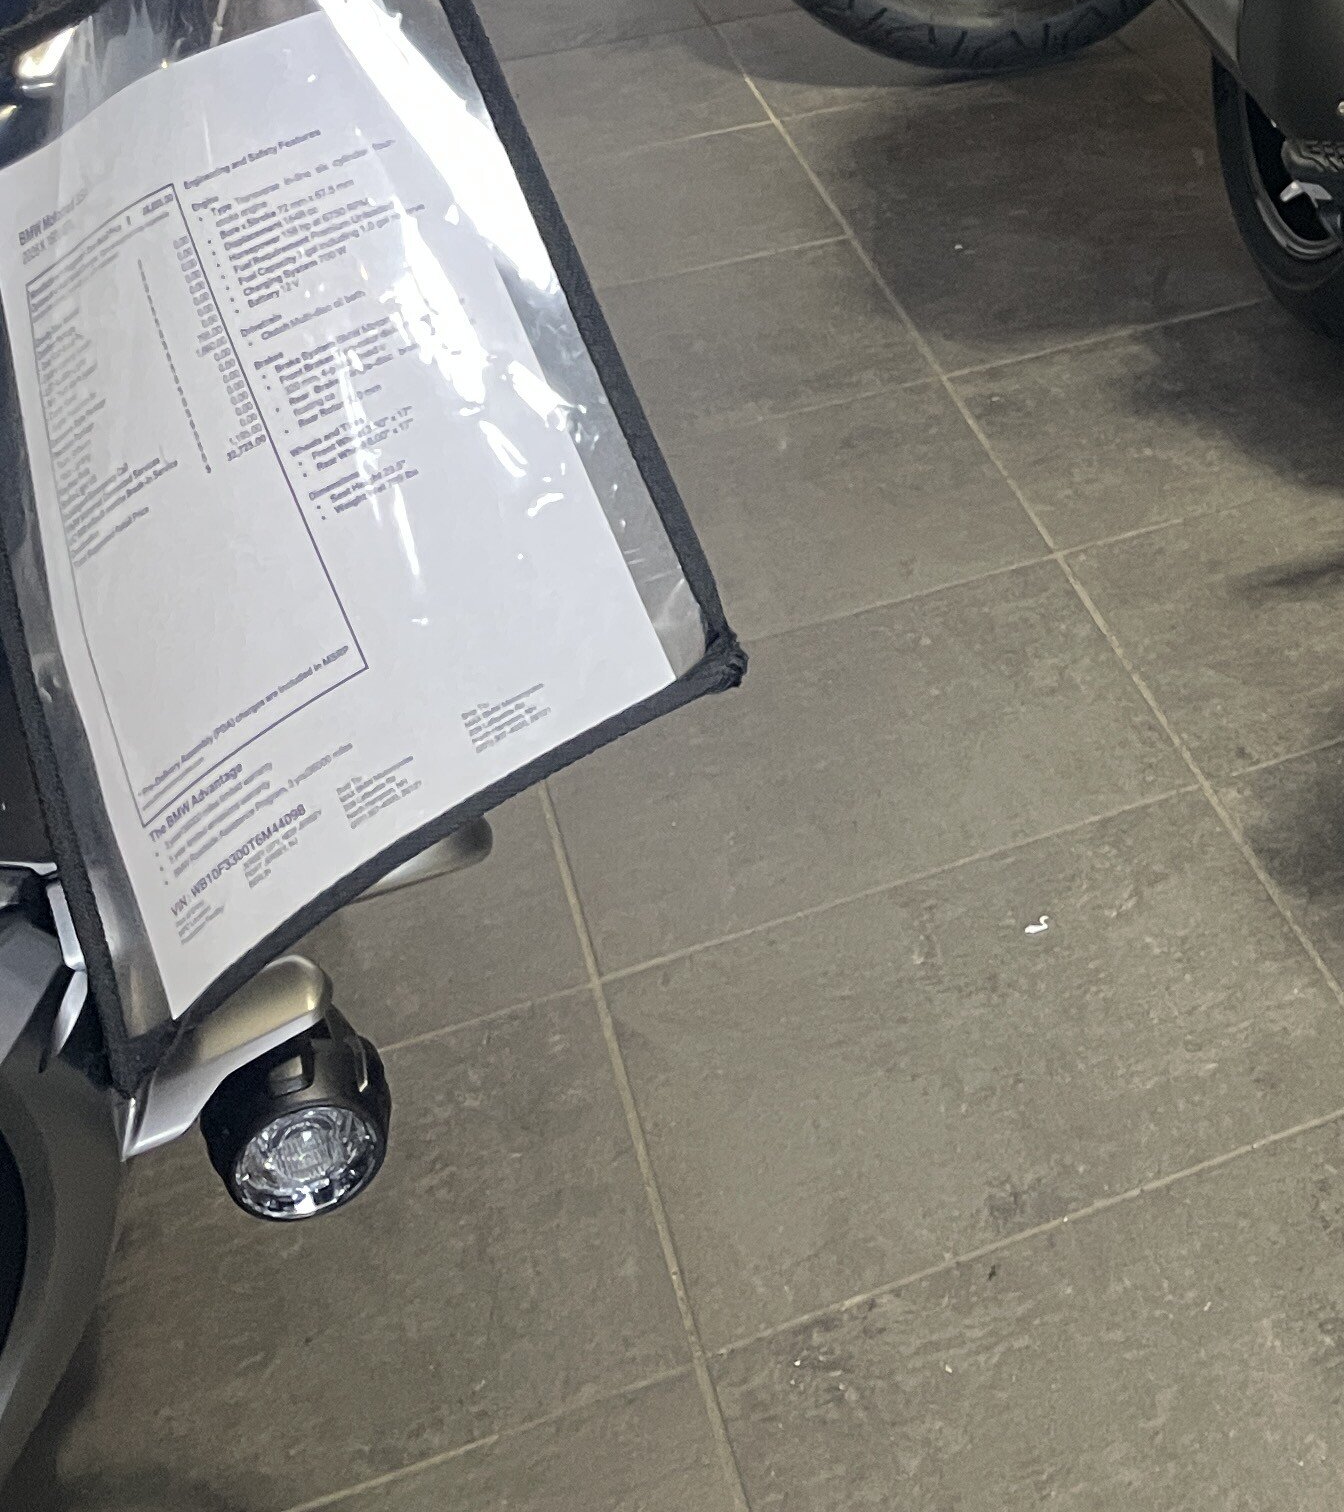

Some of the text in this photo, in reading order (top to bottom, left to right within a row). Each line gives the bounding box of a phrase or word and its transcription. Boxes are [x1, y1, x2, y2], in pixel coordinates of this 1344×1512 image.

[149, 824, 166, 842] The
[165, 801, 190, 829] BMW
[191, 763, 242, 806] Advantage
